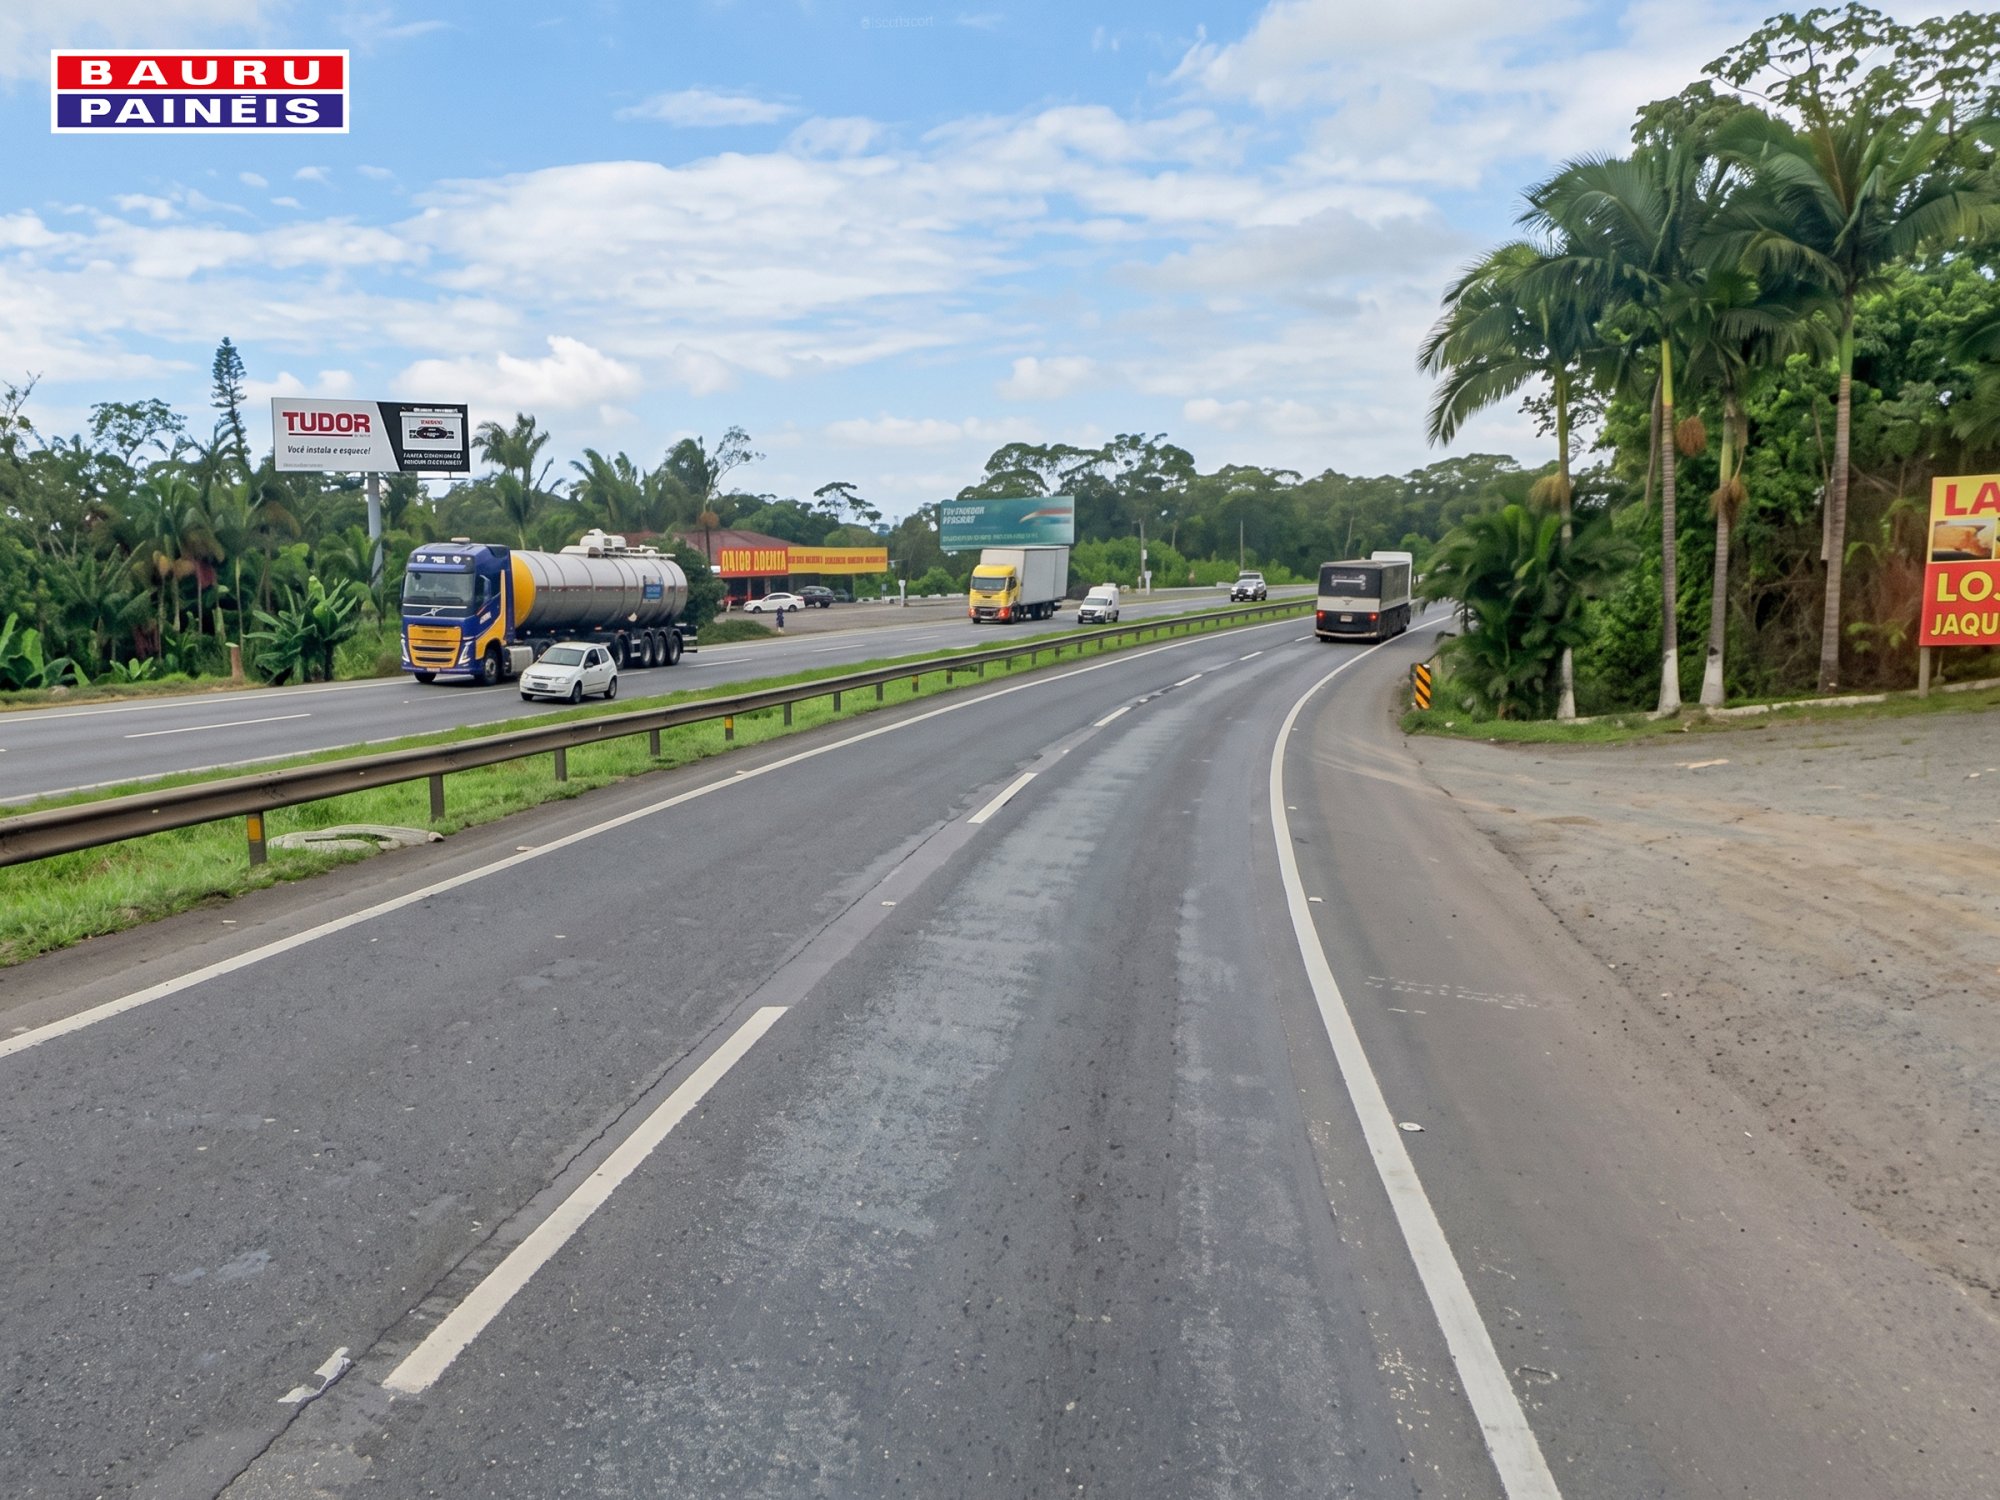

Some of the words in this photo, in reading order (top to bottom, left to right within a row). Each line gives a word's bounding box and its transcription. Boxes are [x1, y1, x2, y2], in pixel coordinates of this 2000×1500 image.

[282, 411, 371, 433] TUDOR
[287, 445, 305, 455] Você
[306, 445, 332, 455] instala
[333, 447, 338, 455] e
[339, 446, 371, 457] esquece!
